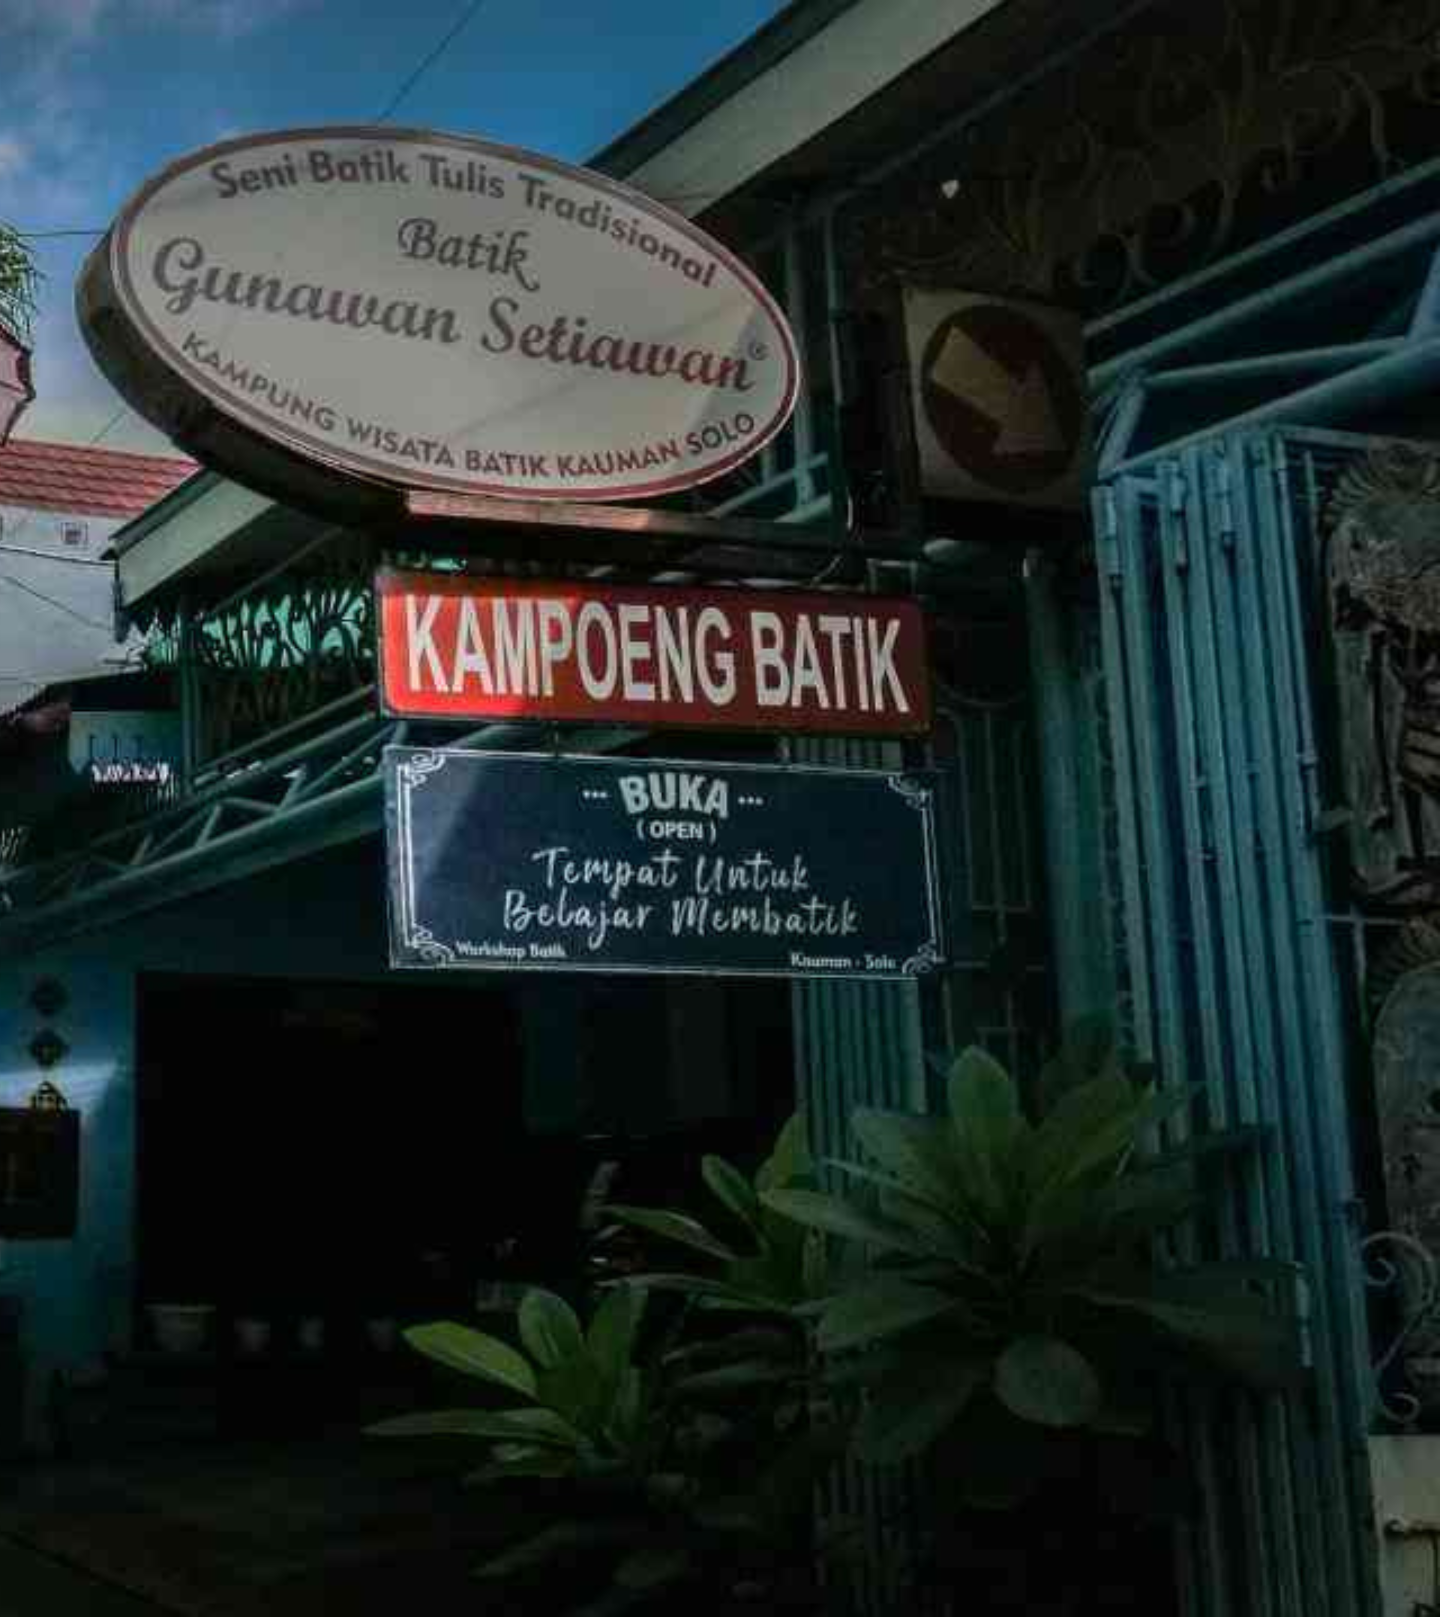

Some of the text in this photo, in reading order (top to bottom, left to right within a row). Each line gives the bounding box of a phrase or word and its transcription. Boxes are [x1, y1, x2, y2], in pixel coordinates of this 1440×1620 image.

[210, 150, 716, 288] Seni Batik Tulis Tradisional
[398, 217, 541, 292] Batik
[152, 237, 755, 391] Gunawan Setiawan
[181, 331, 755, 477] KAMPUNG WISATA BATIK KAUMAN SOLO
[406, 594, 909, 713] KAMPOENG BATIK
[618, 772, 730, 818] BUKA
[531, 847, 809, 899] Tempat Untuk
[455, 940, 567, 959] Workshop Batik
[503, 887, 860, 950] Belajar Membatik
[790, 952, 852, 969] Kauman
[865, 954, 897, 969] Solo
